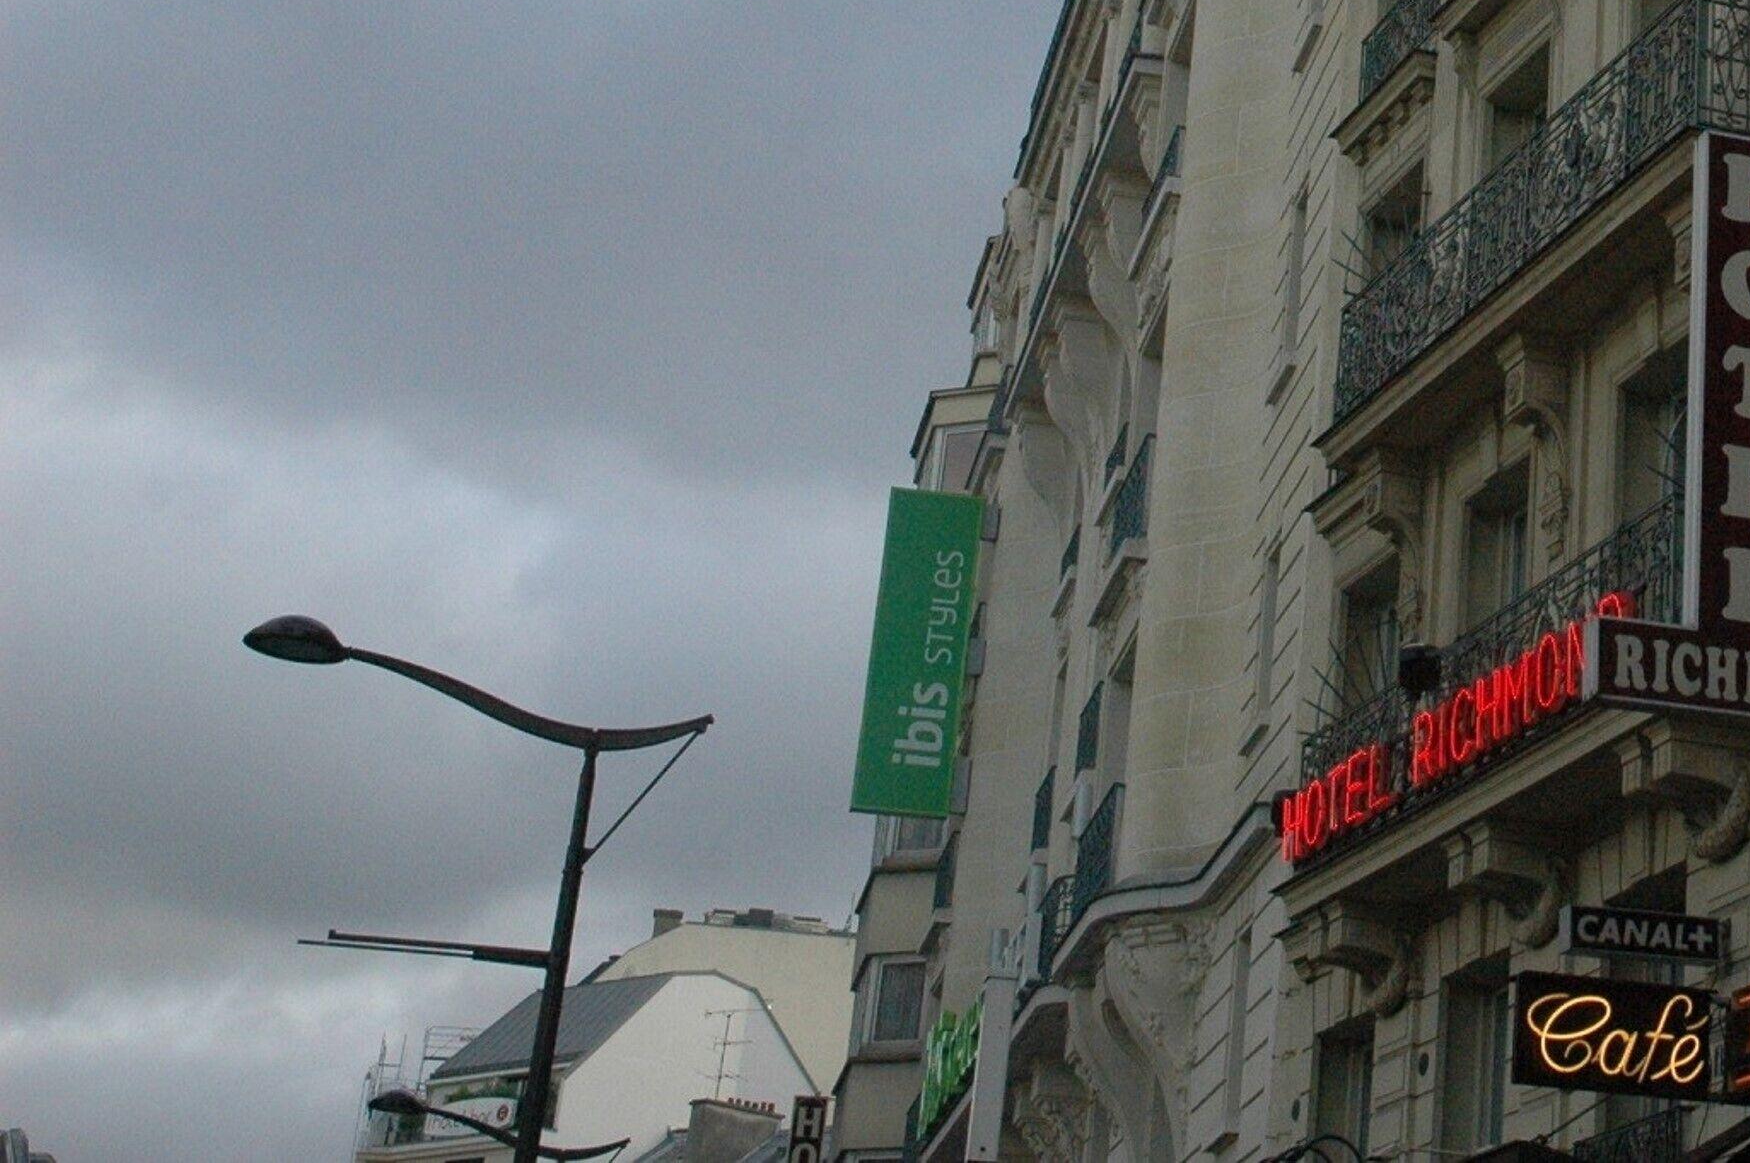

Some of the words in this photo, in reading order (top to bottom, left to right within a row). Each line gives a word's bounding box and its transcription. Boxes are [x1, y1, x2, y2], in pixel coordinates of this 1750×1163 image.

[890, 681, 950, 768] ibis
[1281, 742, 1394, 863] HOTEL
[1576, 914, 1713, 954] CANAL+
[1525, 992, 1710, 1085] Café
